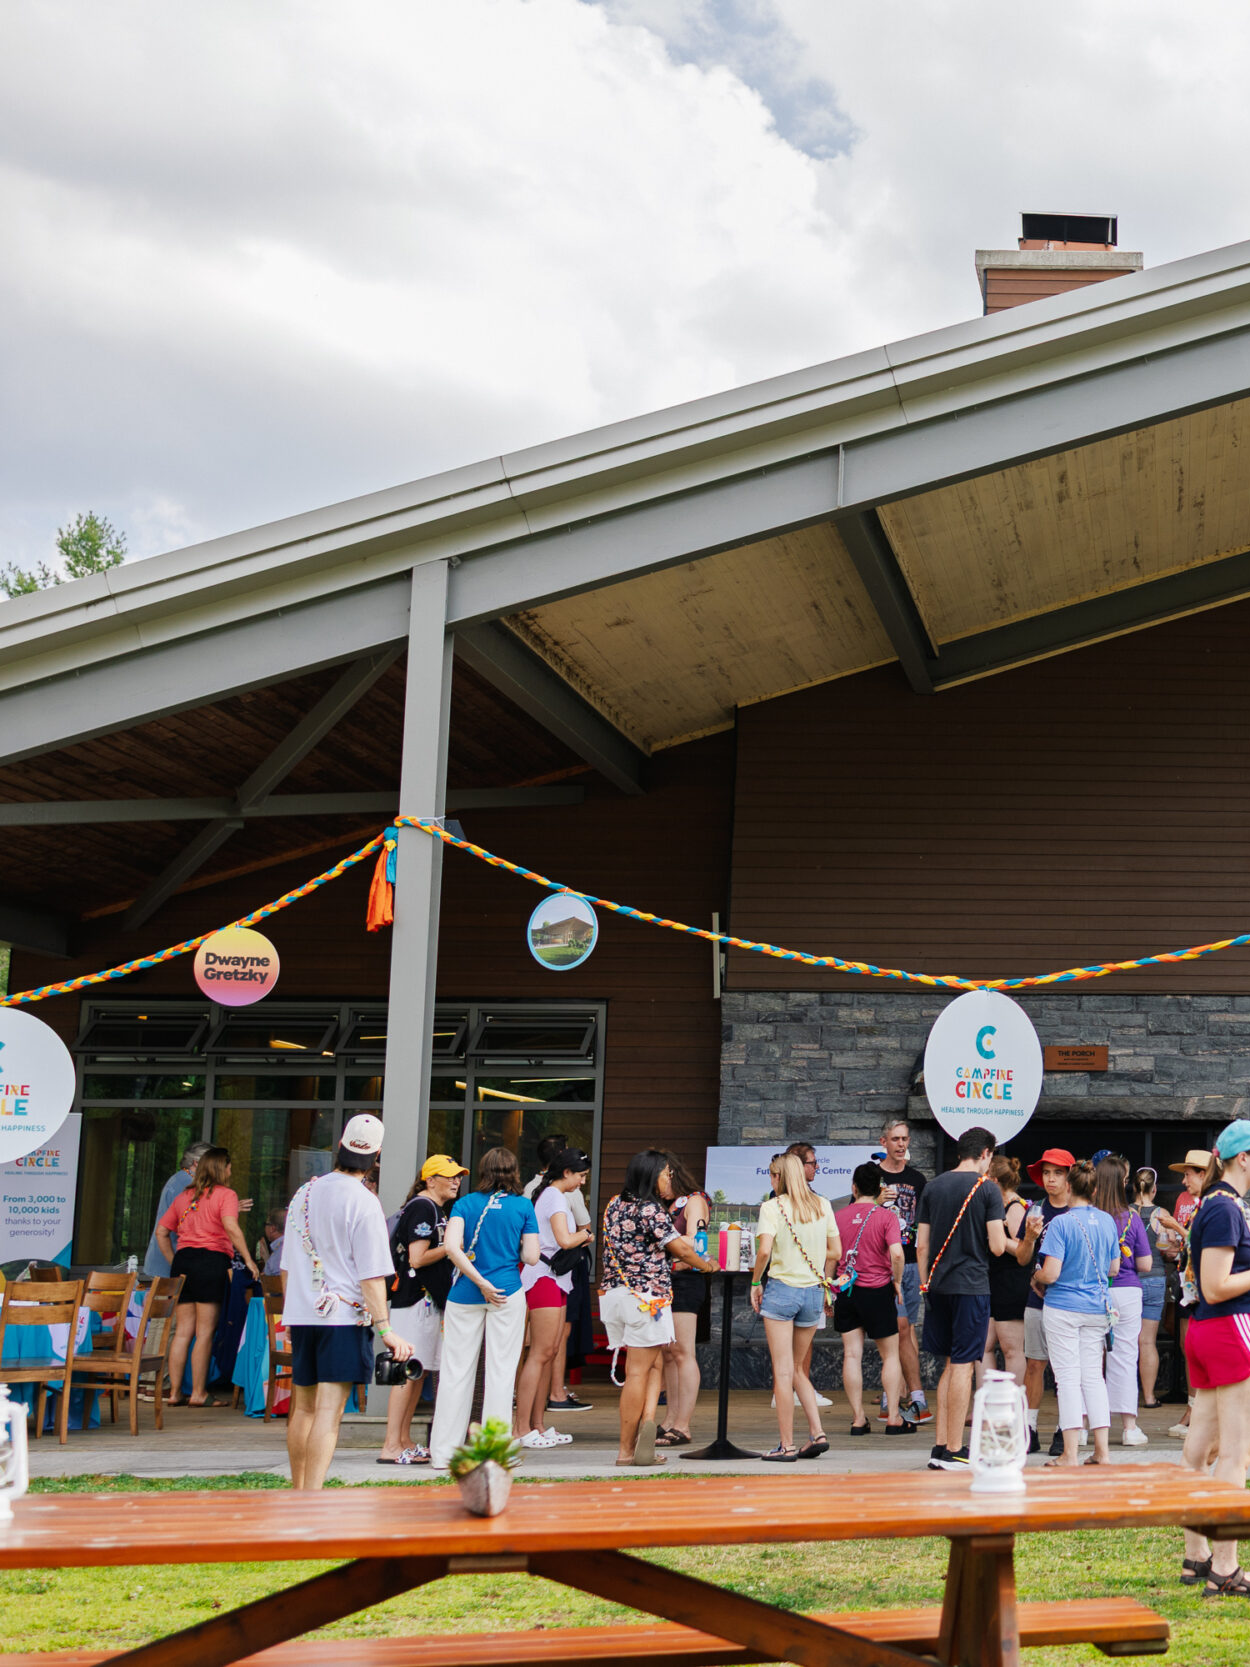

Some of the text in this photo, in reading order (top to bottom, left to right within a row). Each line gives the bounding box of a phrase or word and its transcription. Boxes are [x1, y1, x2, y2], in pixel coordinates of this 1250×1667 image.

[205, 952, 270, 969] Dwayne
[203, 967, 269, 985] Gretzky
[956, 1066, 1013, 1081] CAMPFIRE
[955, 1080, 1013, 1100] CIRCLE
[941, 1106, 1024, 1117] HEALING THROUGH HAPPINESS
[1, 1124, 46, 1132] HAPPINESS
[15, 1157, 60, 1168] CIRCLE
[822, 1167, 852, 1175] Centre
[3, 1195, 26, 1203] From
[28, 1195, 55, 1204] 3,000
[8, 1206, 60, 1215] 10,000 kids
[5, 1217, 31, 1225] thanks
[42, 1219, 61, 1227] your
[9, 1228, 55, 1238] generosity!
